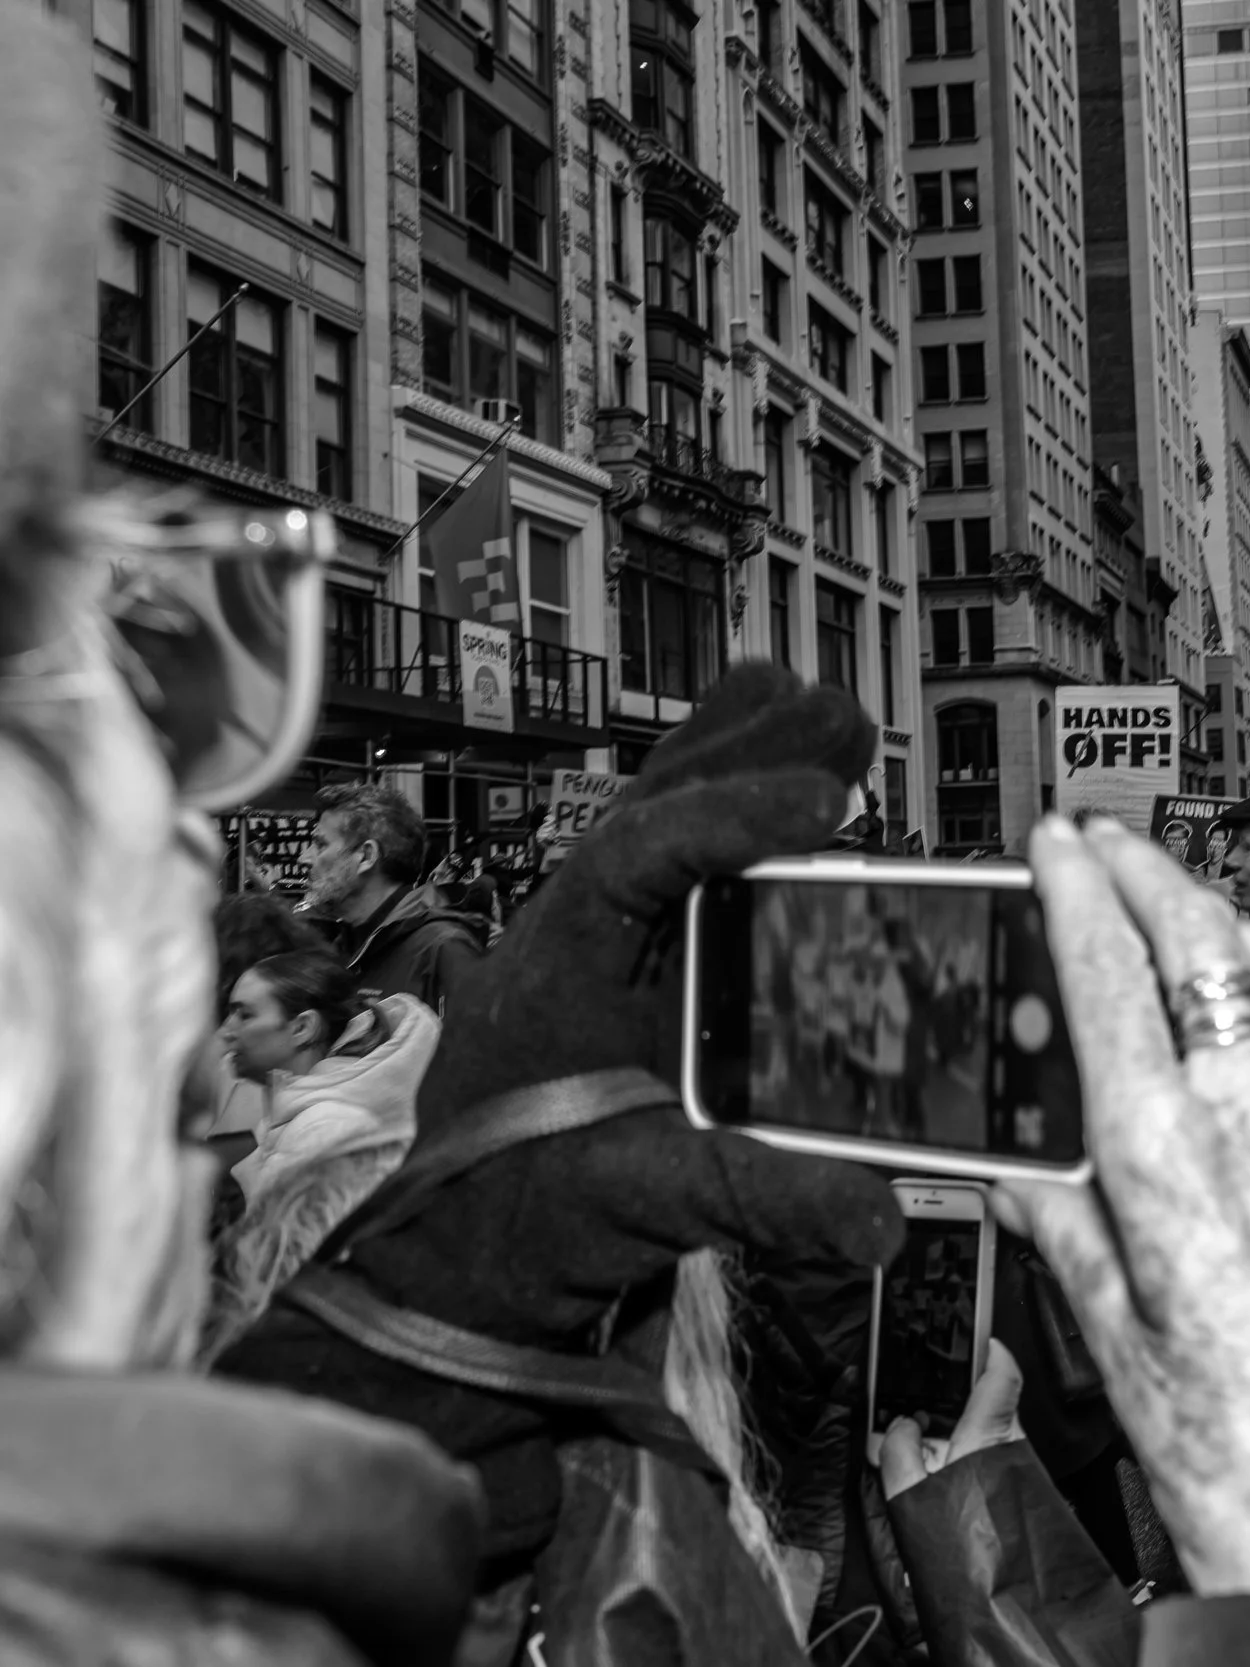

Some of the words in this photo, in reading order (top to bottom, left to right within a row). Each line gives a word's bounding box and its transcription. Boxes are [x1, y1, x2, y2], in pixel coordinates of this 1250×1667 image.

[463, 634, 507, 660] SPRING
[1062, 707, 1171, 729] HANDS
[1165, 800, 1215, 819] FOUND
